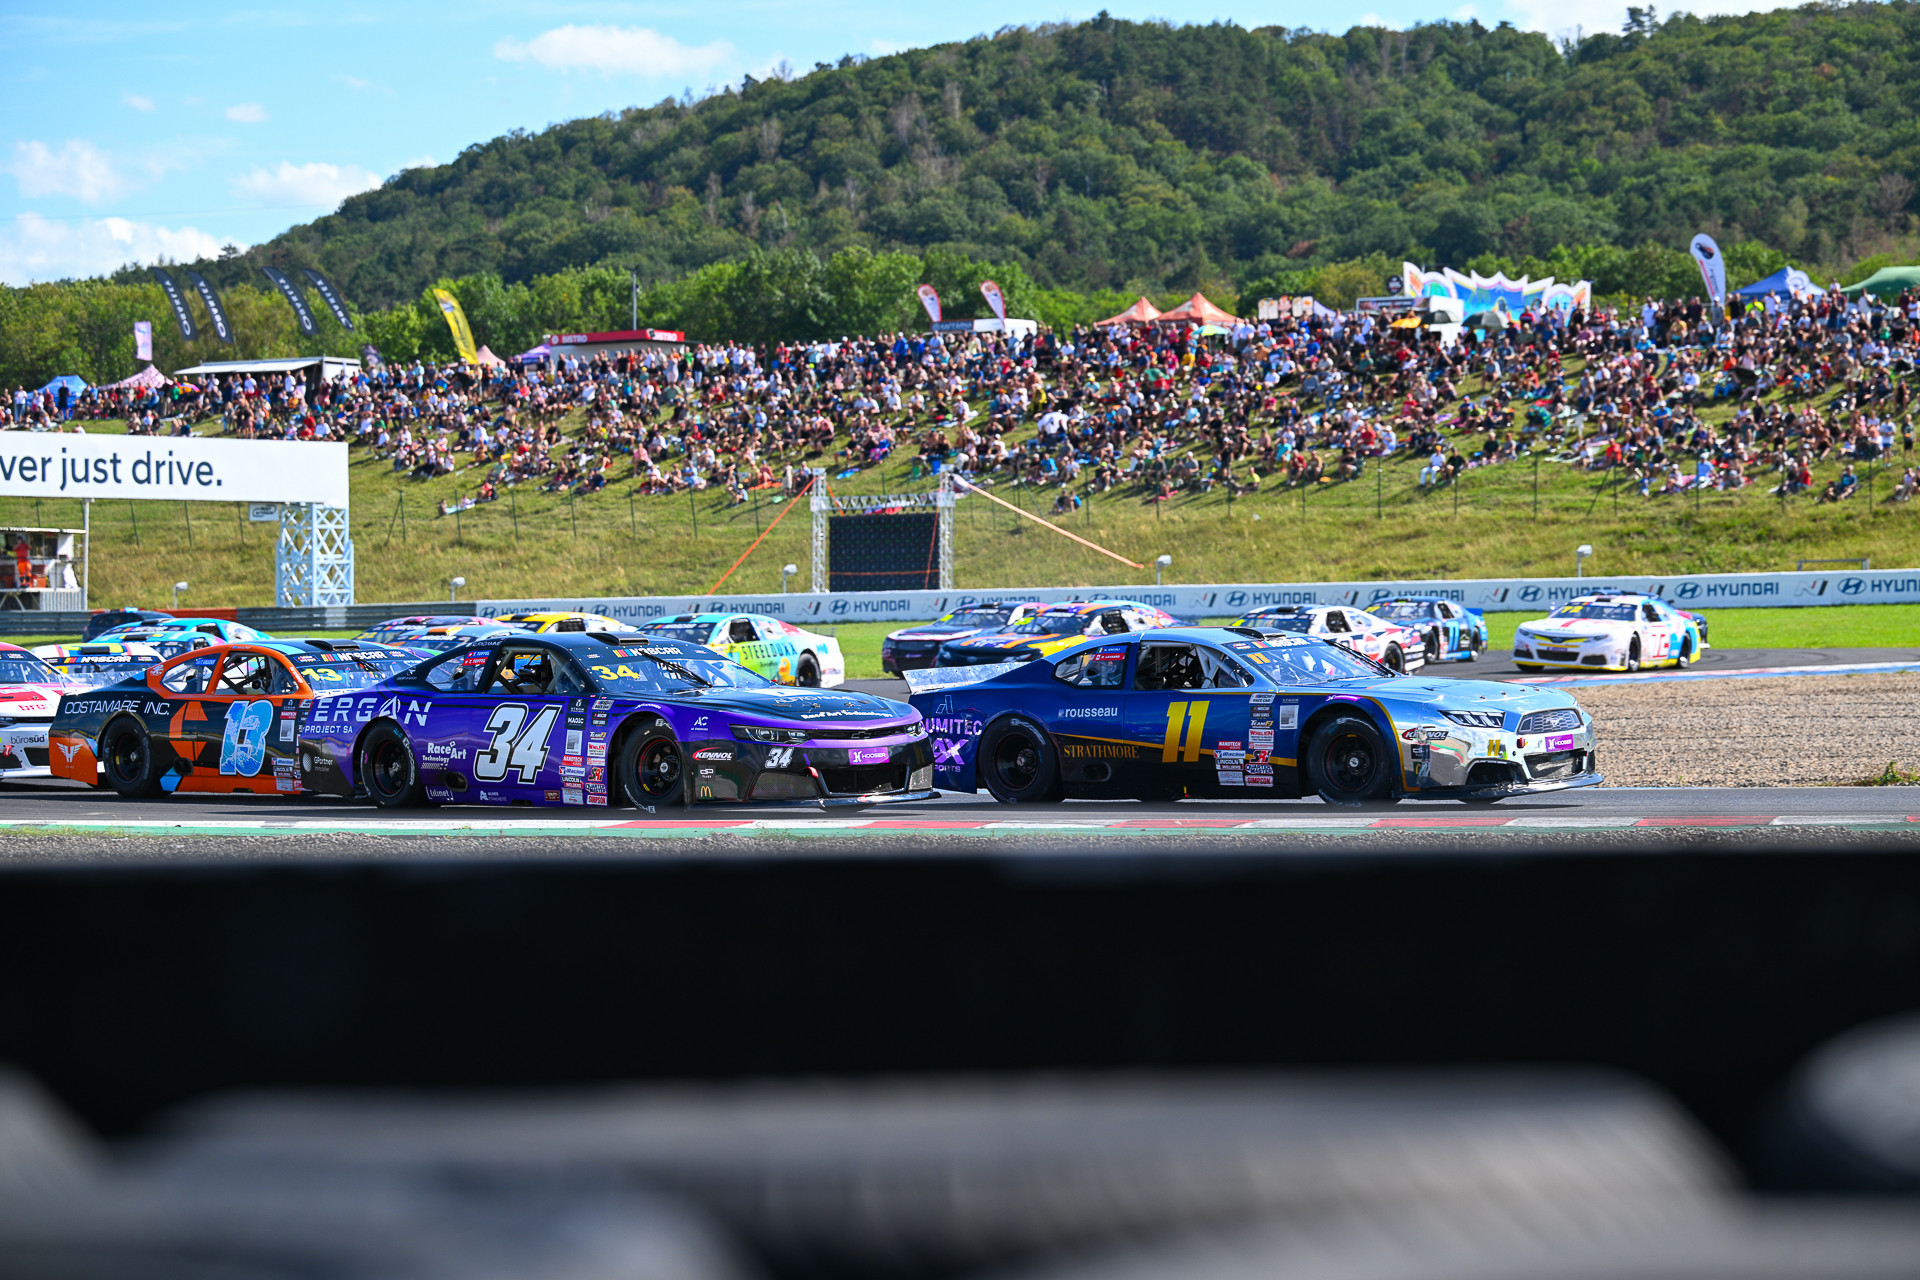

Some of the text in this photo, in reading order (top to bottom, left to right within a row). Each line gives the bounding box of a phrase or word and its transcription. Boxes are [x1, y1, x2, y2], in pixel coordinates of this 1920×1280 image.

[562, 334, 588, 343] BISTRO
[60, 447, 122, 491] just
[131, 450, 223, 487] drive.
[1707, 582, 1779, 596] HYUNDAI
[1115, 594, 1176, 607] HYUNDAI
[1253, 592, 1317, 605] HYUNDAI
[613, 604, 666, 617] HYUNDAI
[730, 602, 785, 615] HYUNDAI
[854, 599, 910, 613] HYUNDAI
[81, 655, 132, 663] NASCAR
[337, 651, 388, 662] NASCAR
[1246, 652, 1271, 664] 11
[301, 667, 343, 682] 13
[591, 664, 640, 681] 34
[64, 700, 171, 715] COSTAMARE INC.
[1065, 706, 1118, 718] rousseau
[304, 725, 353, 734] PROJECT SA
[1161, 700, 1210, 763] 11
[218, 699, 275, 777] 13
[472, 702, 563, 785] 34
[427, 742, 467, 760] Race Art
[1063, 744, 1140, 759] STRATHMORE
[1487, 739, 1501, 757] 11
[422, 754, 450, 764] Technology
[695, 751, 733, 759] KENNOL
[764, 747, 795, 769] 34
[561, 775, 581, 783] LINCOLN
[1247, 777, 1271, 785] SIMPSON
[588, 795, 607, 804] SIMPSON
